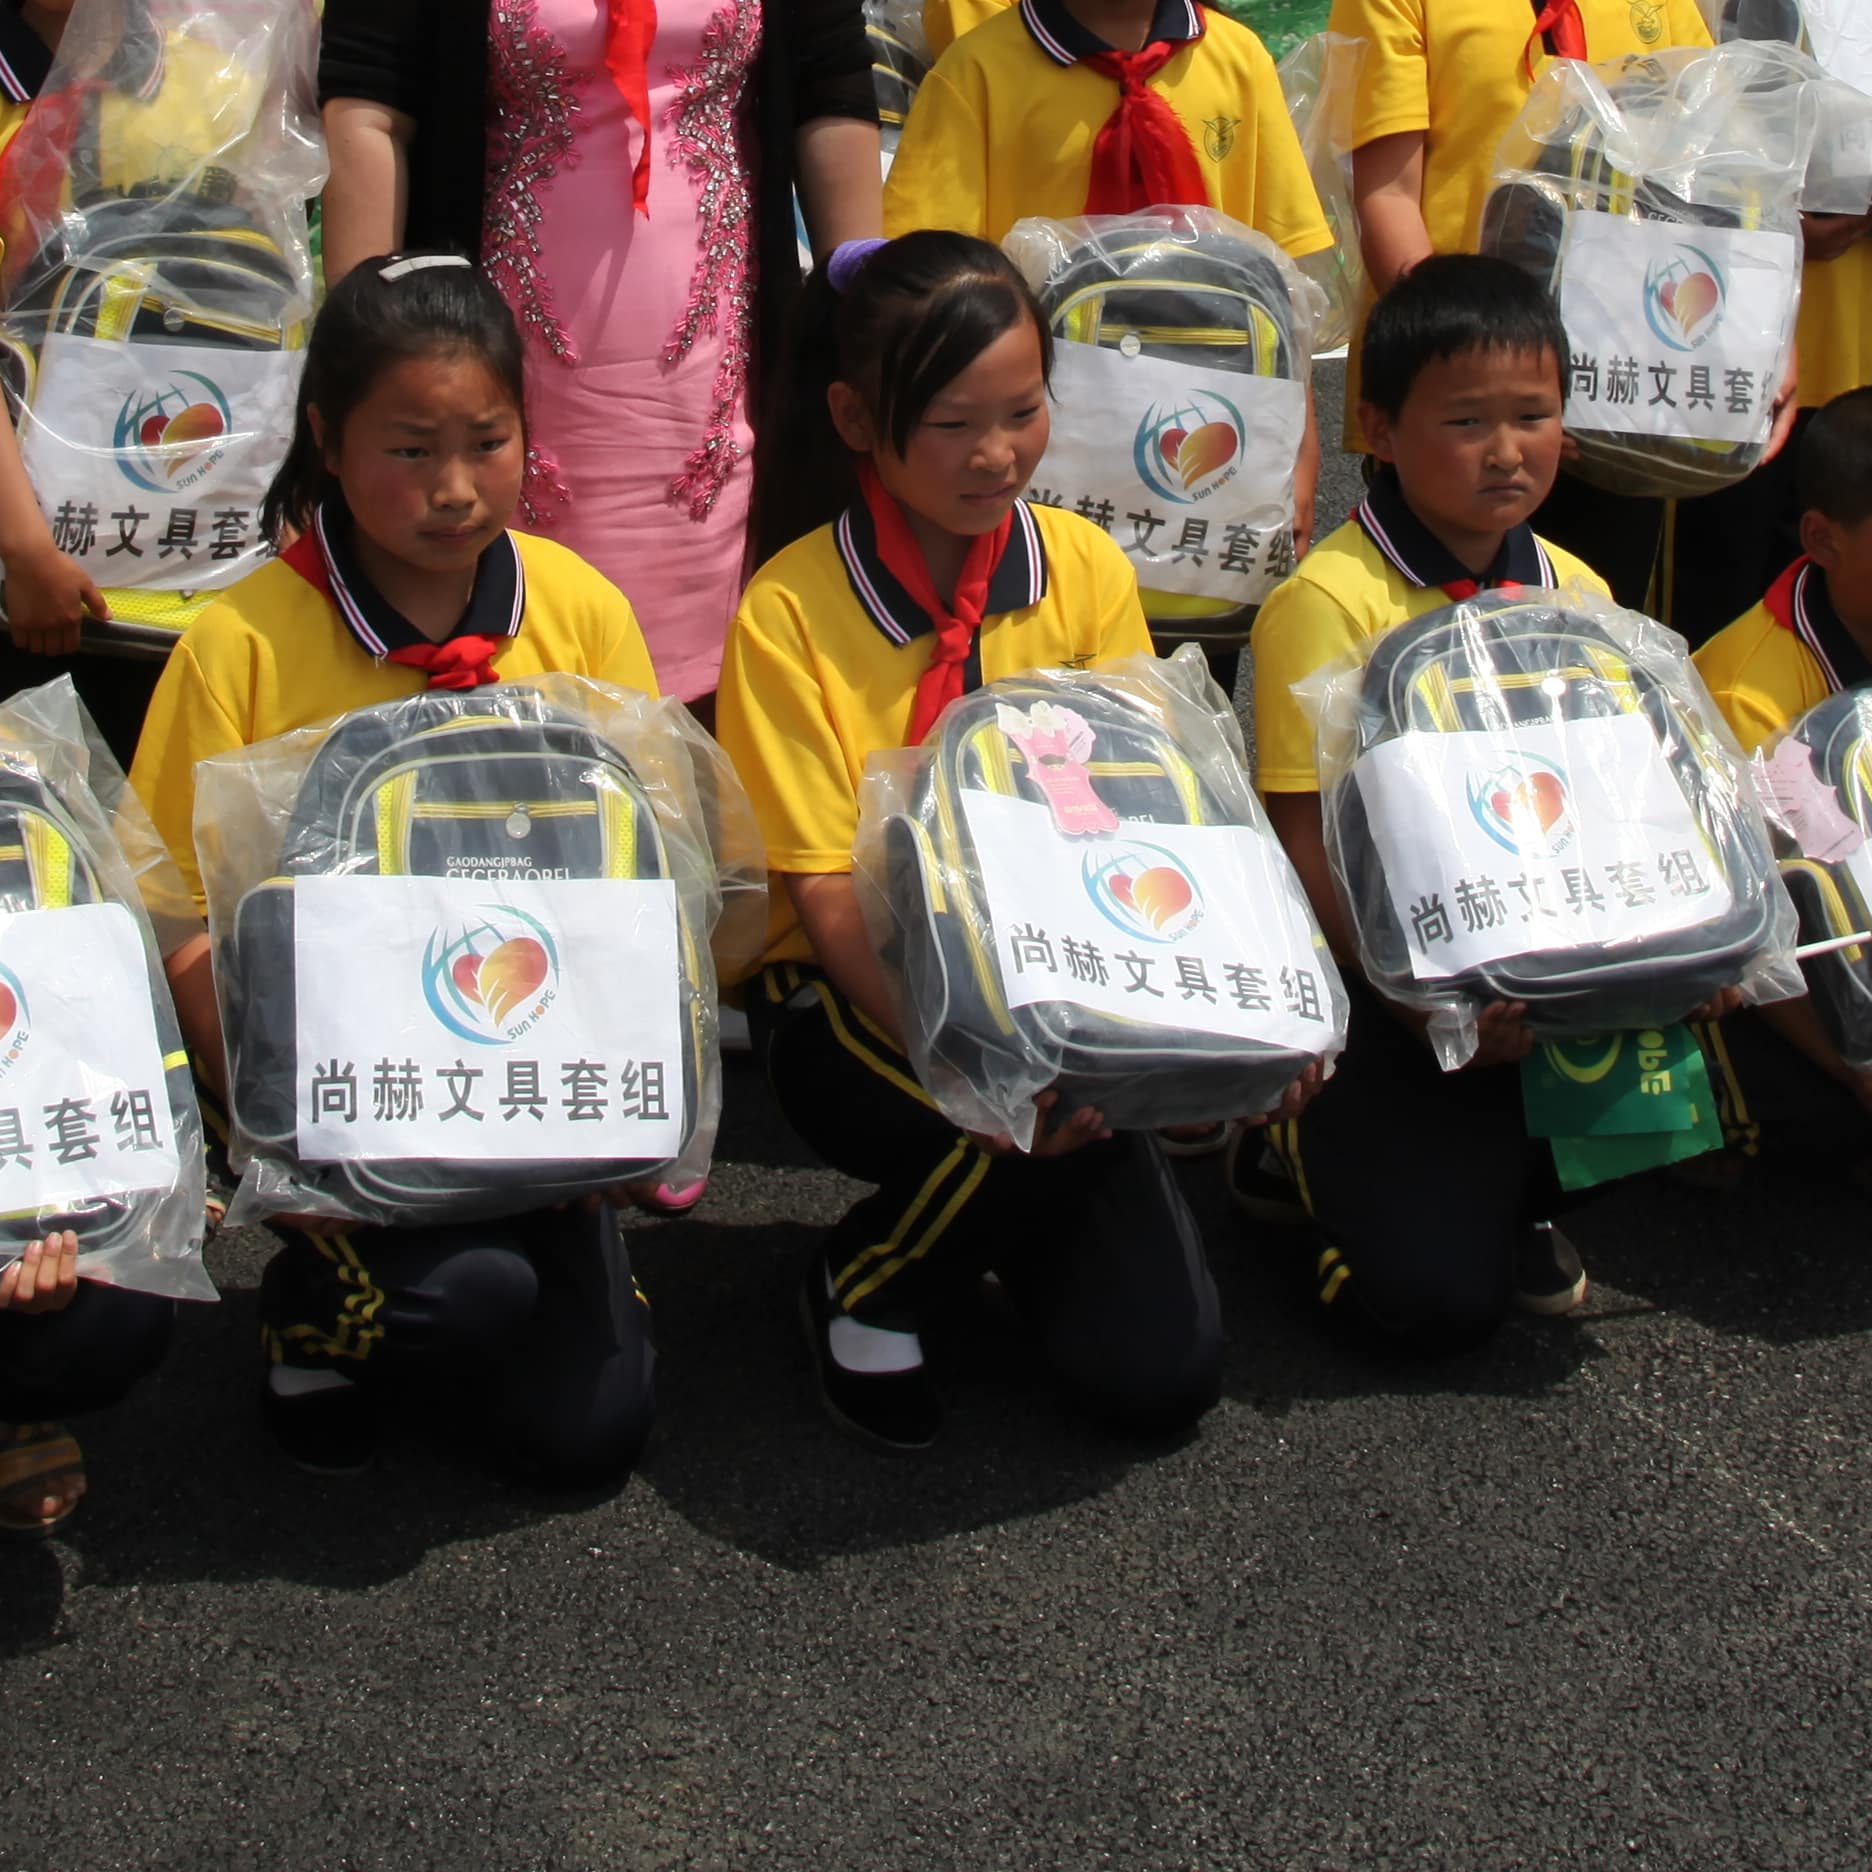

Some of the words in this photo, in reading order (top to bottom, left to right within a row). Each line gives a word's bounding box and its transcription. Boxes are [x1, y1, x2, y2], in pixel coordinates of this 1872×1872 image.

[1410, 848, 1711, 955] 尚赫文具套组
[1009, 922, 1325, 1023] 尚赫文具套组
[311, 1057, 671, 1123] 尚赫文具套组
